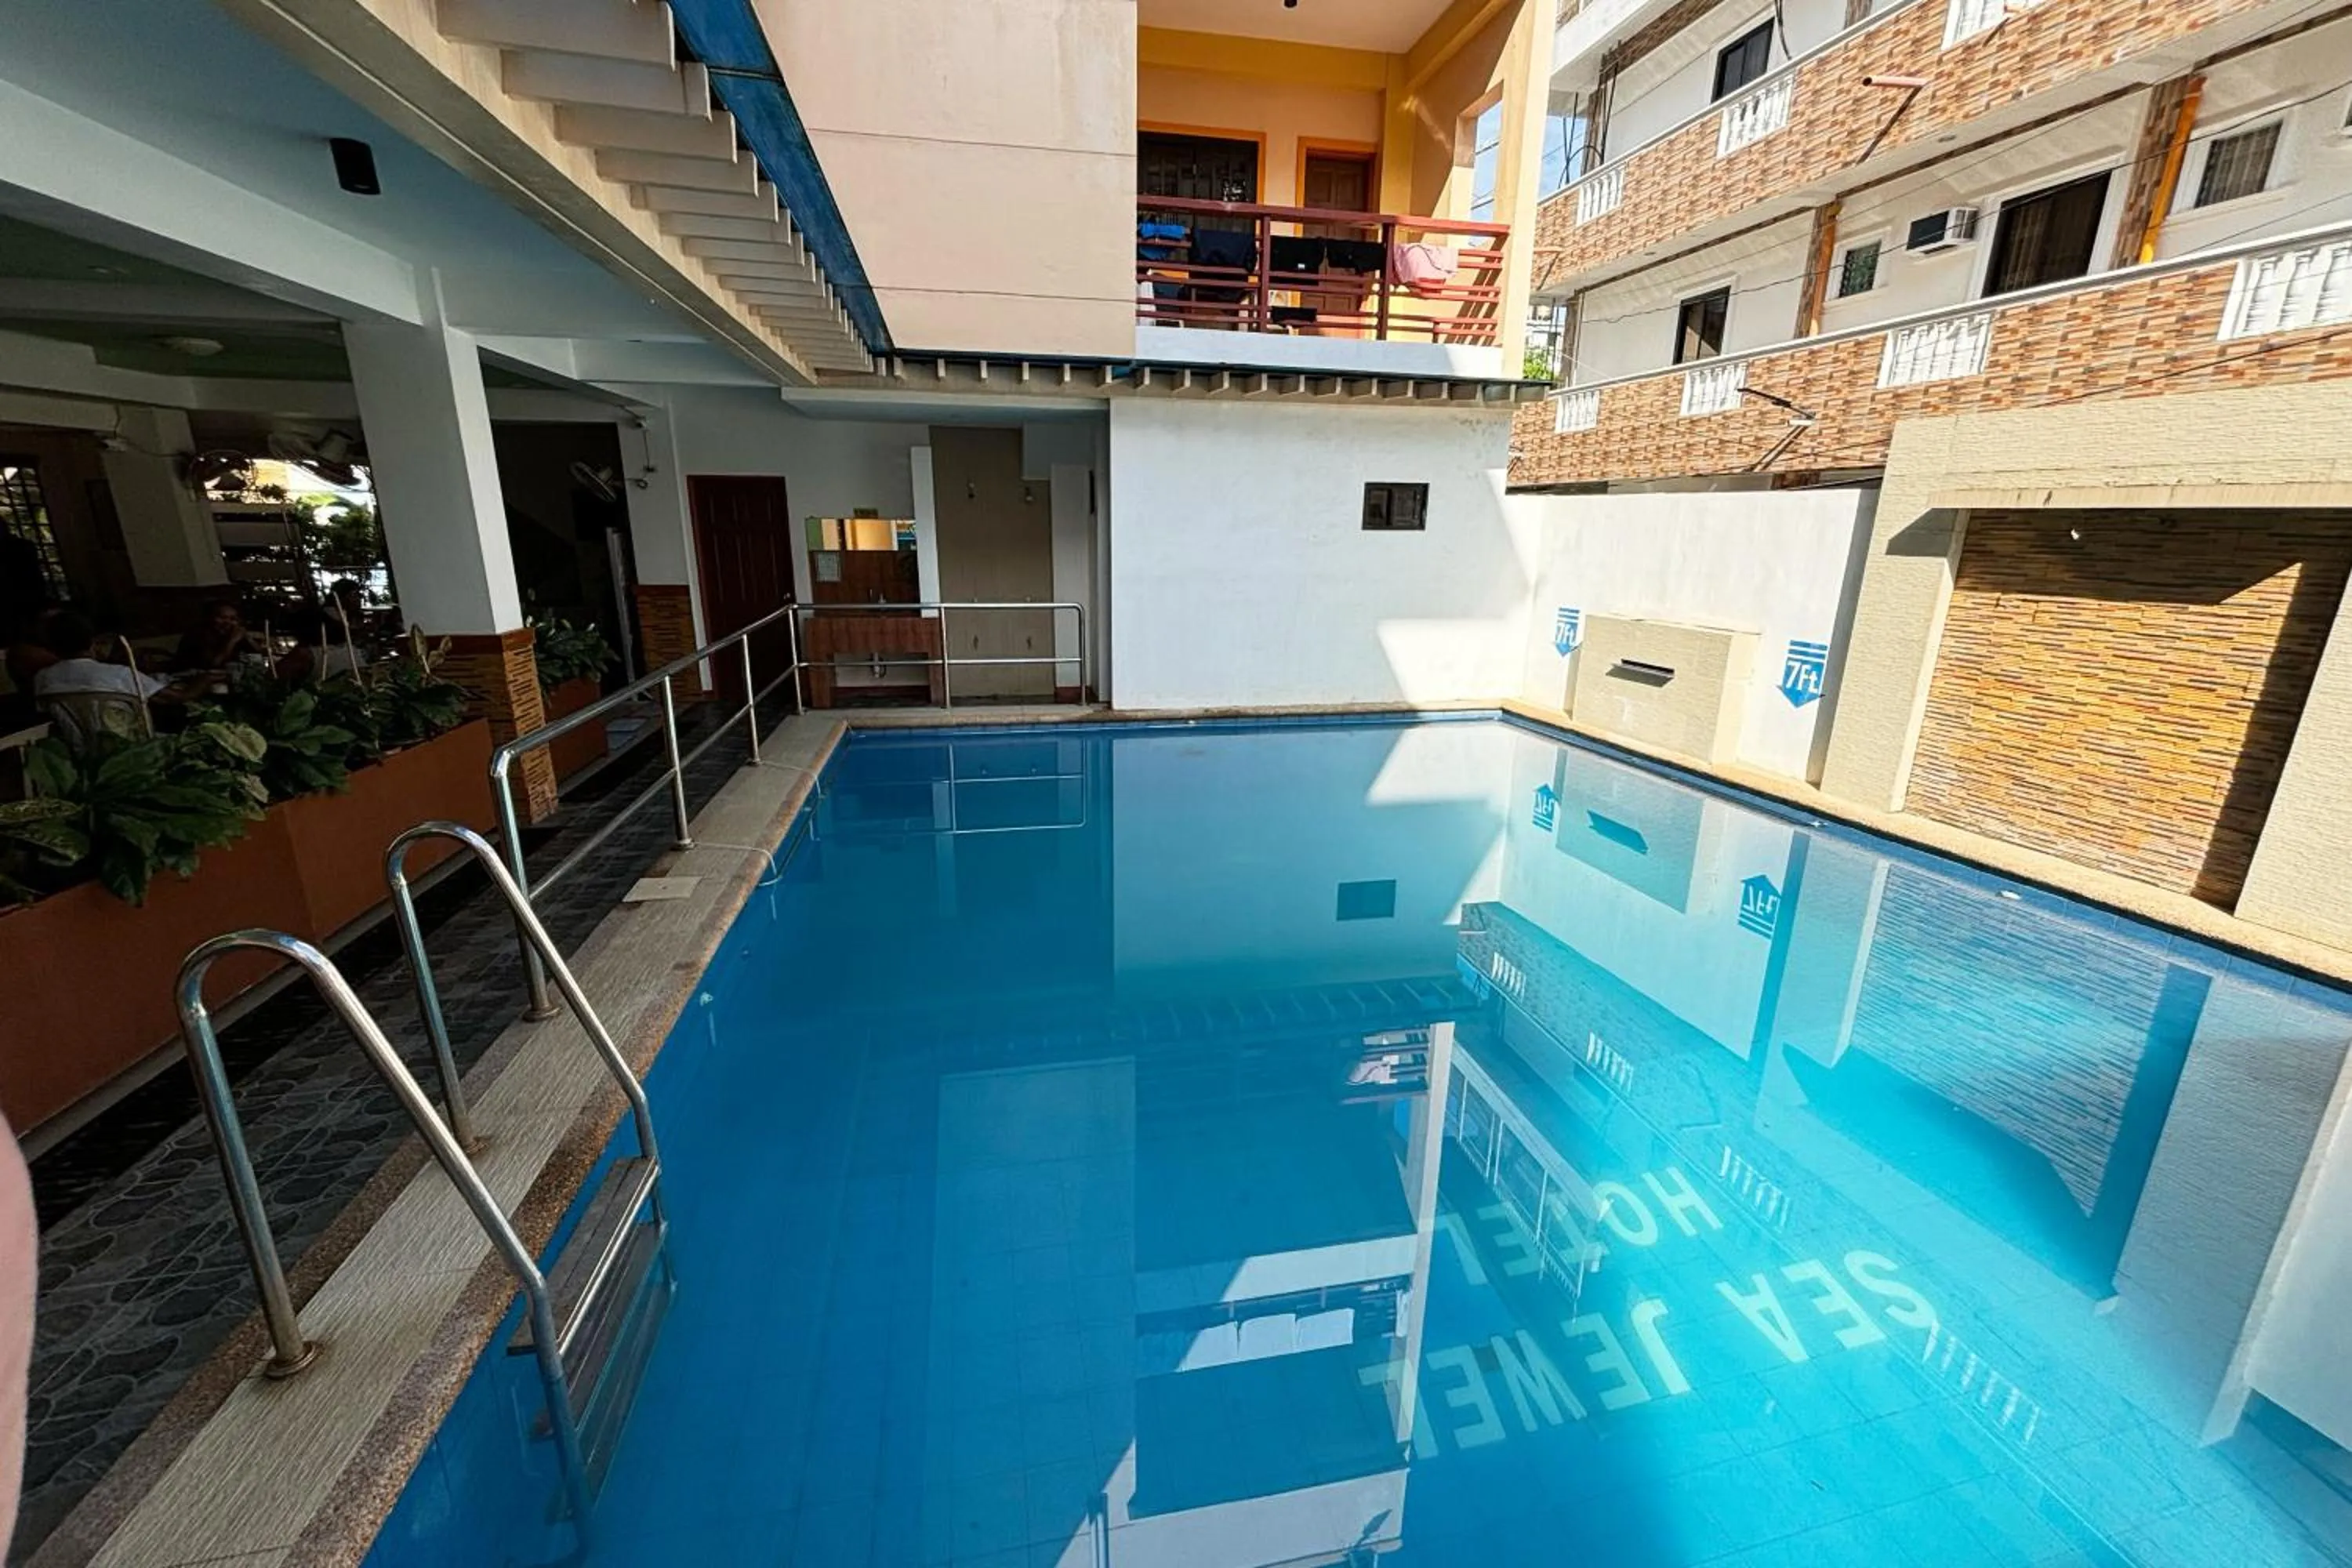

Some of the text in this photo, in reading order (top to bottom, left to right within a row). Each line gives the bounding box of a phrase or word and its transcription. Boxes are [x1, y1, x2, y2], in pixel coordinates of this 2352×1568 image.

[1416, 1167, 1721, 1286] HOTEL
[1359, 1249, 1940, 1459] SEA JEWEL
